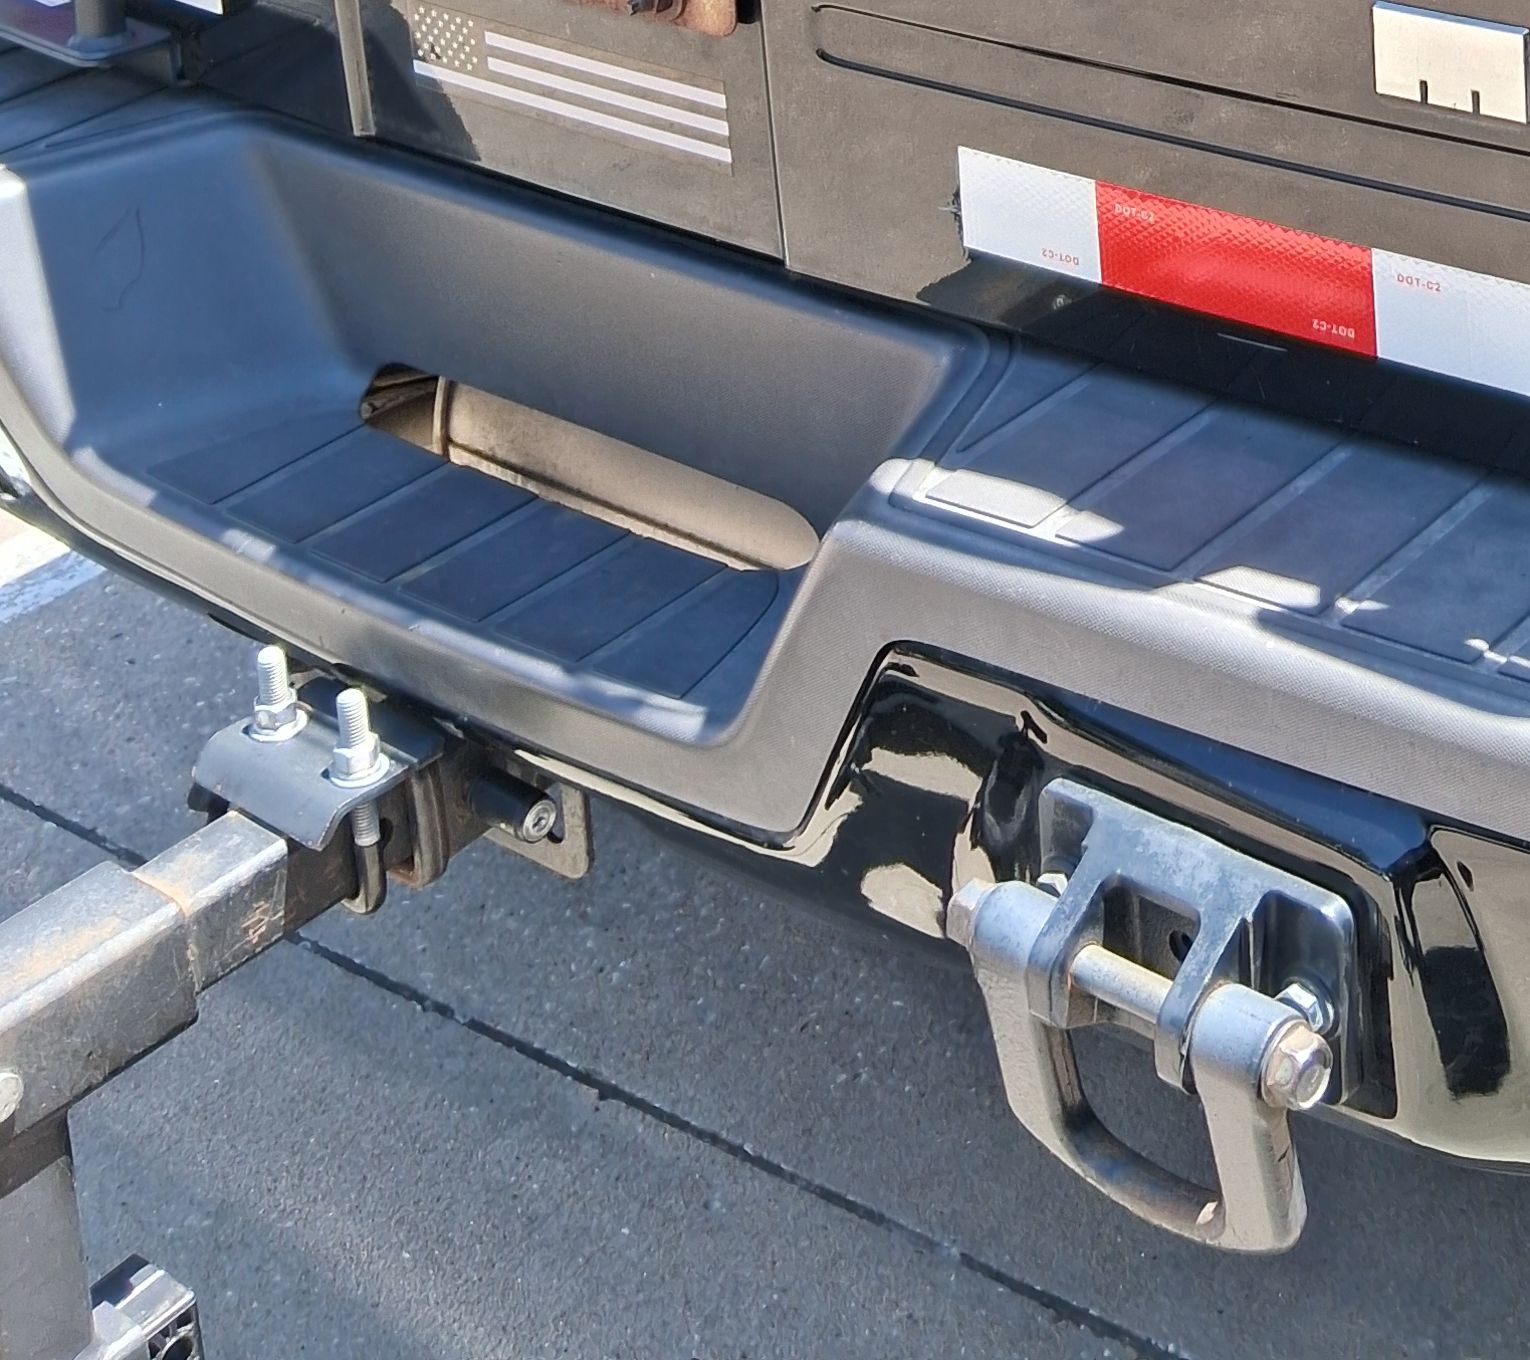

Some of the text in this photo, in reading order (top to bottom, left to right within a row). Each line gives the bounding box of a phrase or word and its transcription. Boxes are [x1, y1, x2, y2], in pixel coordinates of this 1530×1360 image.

[1114, 203, 1155, 224] DOT-C2
[1041, 247, 1080, 266] DOT-C2
[1397, 272, 1441, 292] DOT-C2
[1312, 319, 1356, 339] DOT-C2
